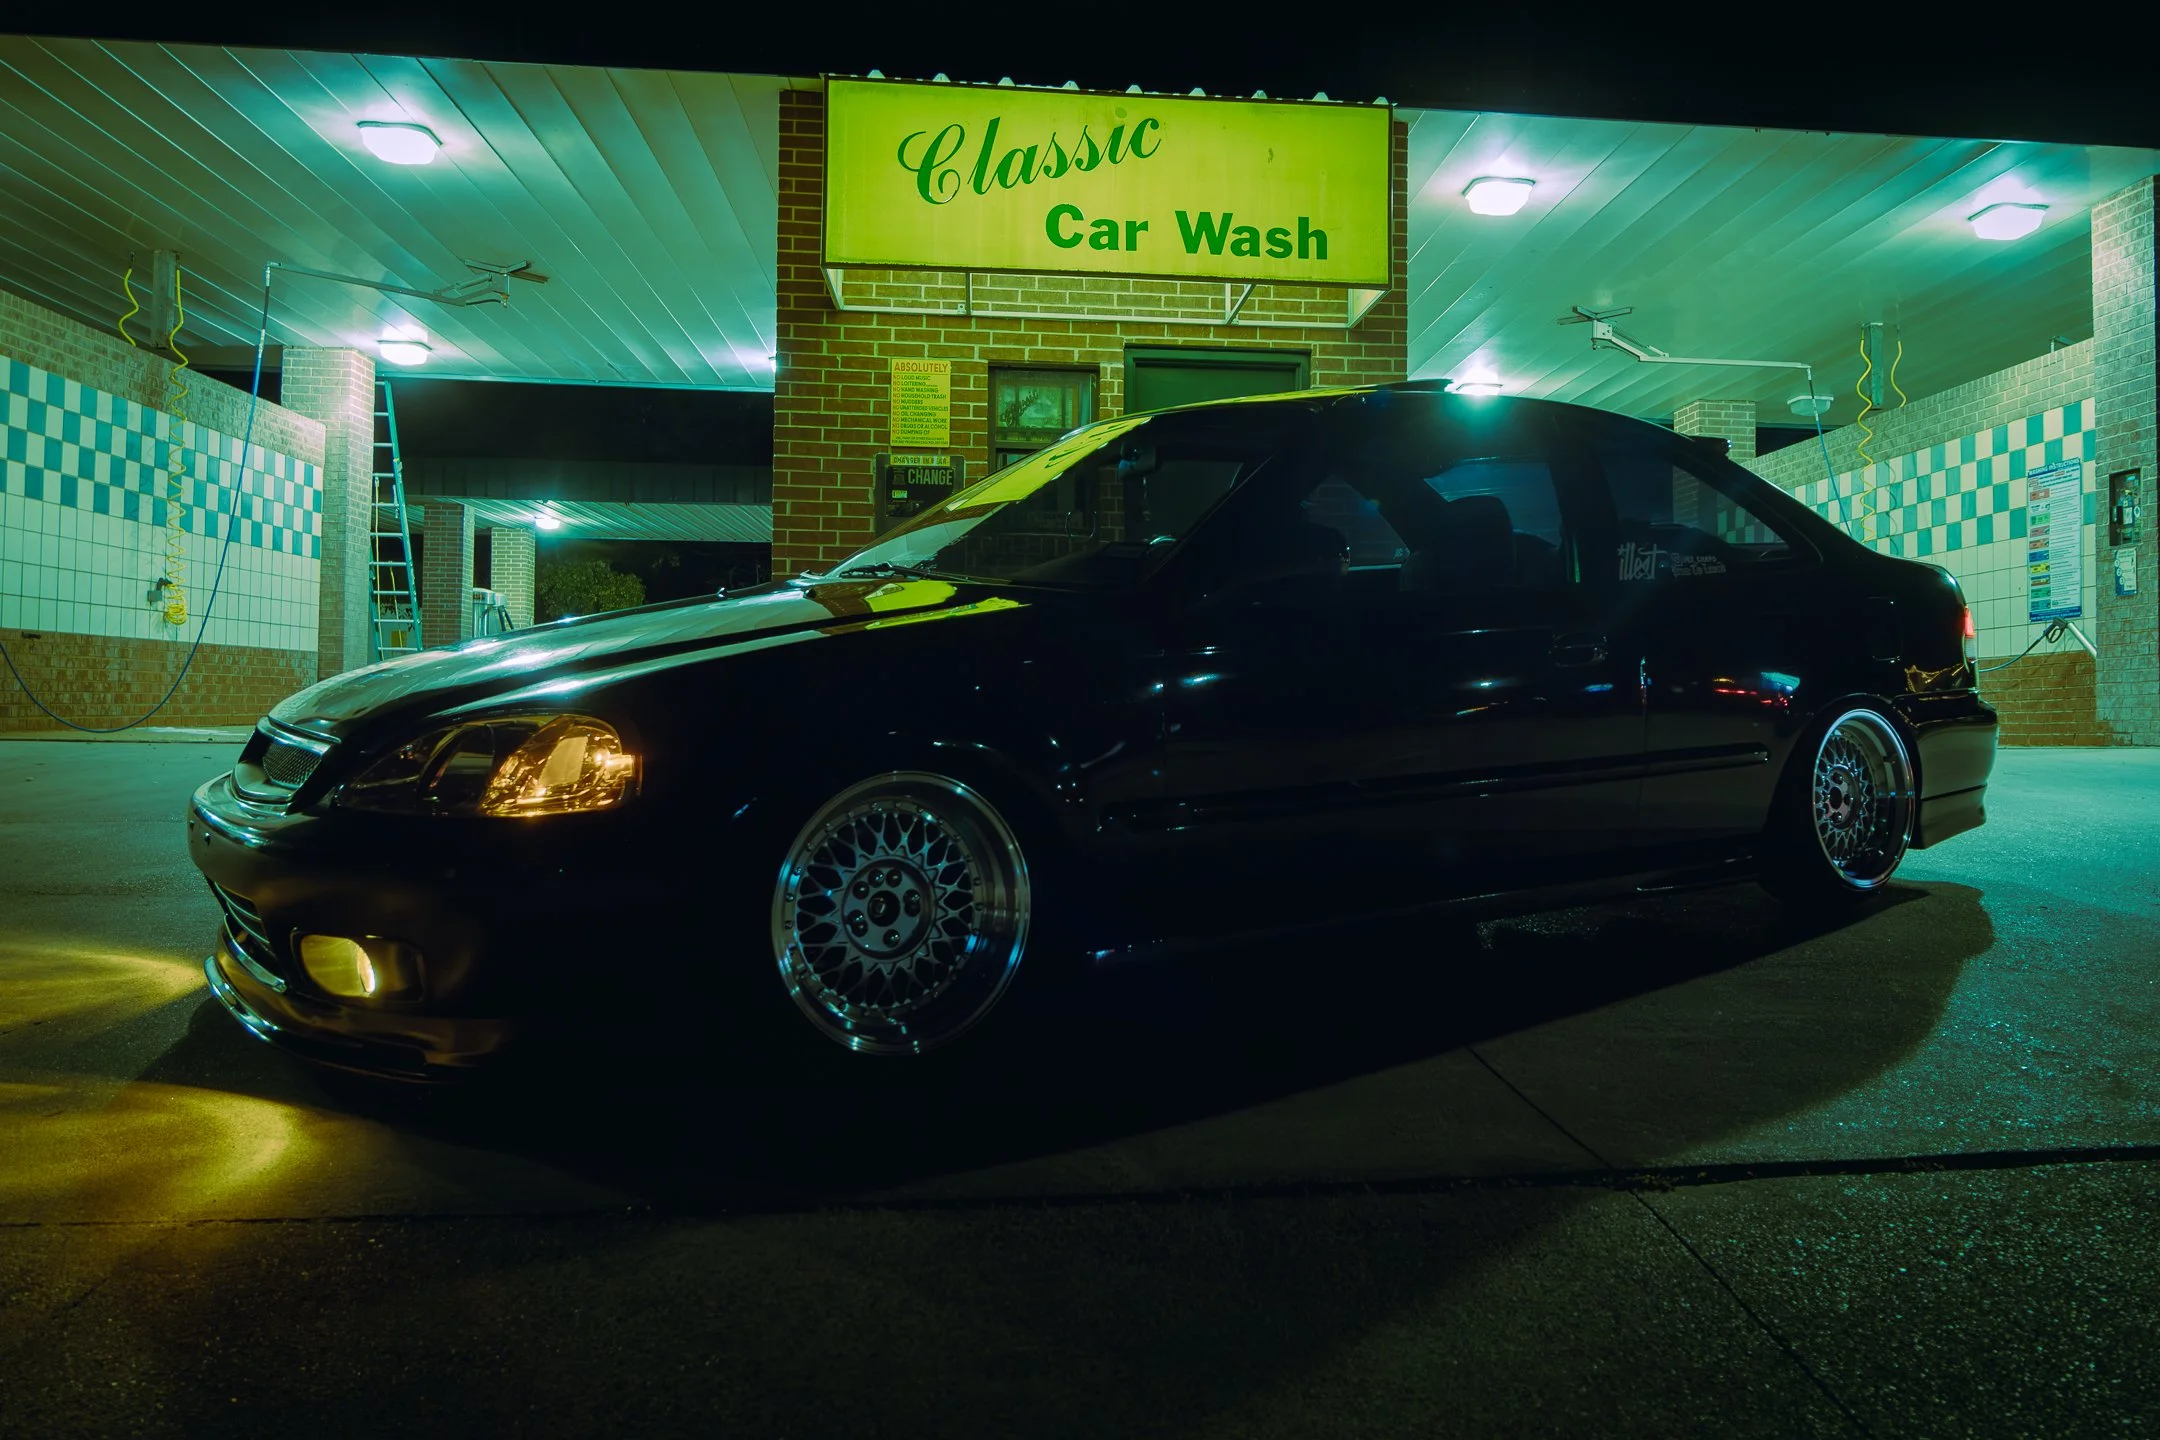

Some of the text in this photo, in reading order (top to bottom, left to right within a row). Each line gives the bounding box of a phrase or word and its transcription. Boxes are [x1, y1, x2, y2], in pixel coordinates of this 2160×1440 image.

[896, 115, 1163, 205] Classic
[1045, 203, 1328, 260] Car Wash
[894, 362, 948, 373] ABSOLUTELY
[907, 468, 953, 485] CHANGE
